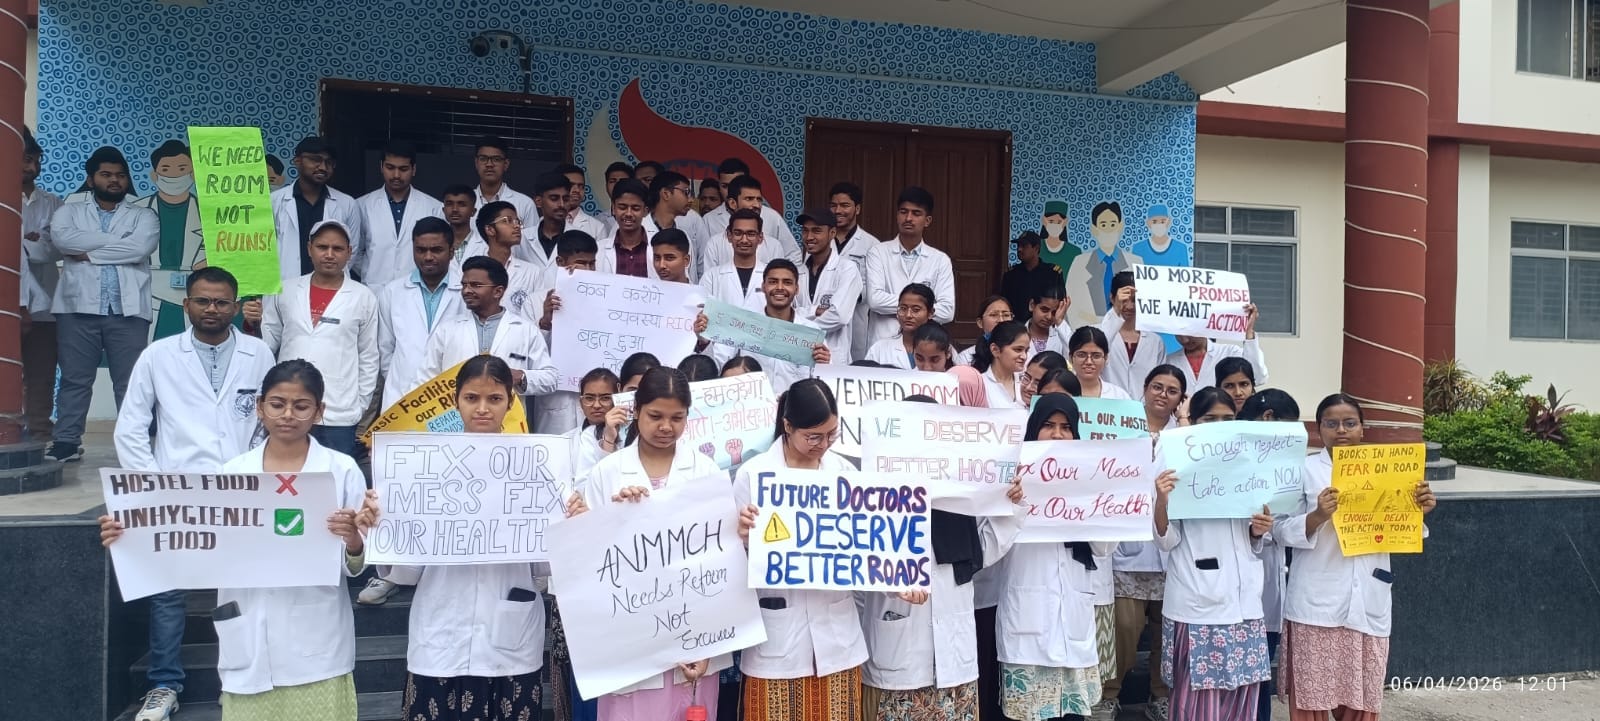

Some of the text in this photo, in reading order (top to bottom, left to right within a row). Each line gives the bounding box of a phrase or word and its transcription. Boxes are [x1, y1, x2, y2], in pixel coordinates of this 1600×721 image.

[198, 145, 265, 166] WE NEED
[206, 173, 265, 194] ROOM
[215, 205, 255, 224] NOT
[215, 229, 274, 252] RUINS!
[1136, 265, 1216, 285] NO MORE
[576, 281, 611, 299] कब
[1188, 285, 1249, 302] PROMISE
[1137, 298, 1212, 320] WE WANT
[666, 316, 694, 333] RIG
[1206, 313, 1249, 332] ACTION
[398, 379, 457, 414] Facilitie
[415, 406, 437, 423] our
[428, 410, 459, 432] REPAIR
[1078, 411, 1149, 432] AL OUR HOSTE
[874, 417, 901, 438] WE
[923, 419, 1021, 445] DESERVE
[1185, 434, 1248, 462] Enough
[1338, 448, 1368, 461] BOOKS
[1372, 448, 1385, 459] IN
[385, 444, 556, 481] FIX OUR
[958, 457, 1017, 484] HOSTE
[1040, 457, 1079, 482] Our
[1089, 457, 1141, 481] Mess
[1340, 462, 1419, 477] FEAR ON ROAD
[110, 474, 260, 495] HOSTEL FOOD
[1187, 466, 1302, 500] take action NOW
[387, 479, 568, 515] MESS FIX
[1044, 496, 1086, 521] Our
[1088, 492, 1151, 518] Health
[113, 505, 265, 529] UNHYGIENIC
[1343, 513, 1411, 523] ENOUGH DELAY
[375, 519, 549, 556] OUR HEALTH
[796, 511, 927, 554] DESERVE
[1357, 524, 1385, 533] ACTION
[1390, 524, 1418, 533] TODAY
[153, 531, 217, 552] FOOD
[597, 519, 723, 588] ANMMCH
[766, 551, 931, 586] BETTER ROADS
[612, 563, 728, 617] Needs Reform
[652, 603, 692, 638] Not
[674, 626, 736, 650] Excuses
